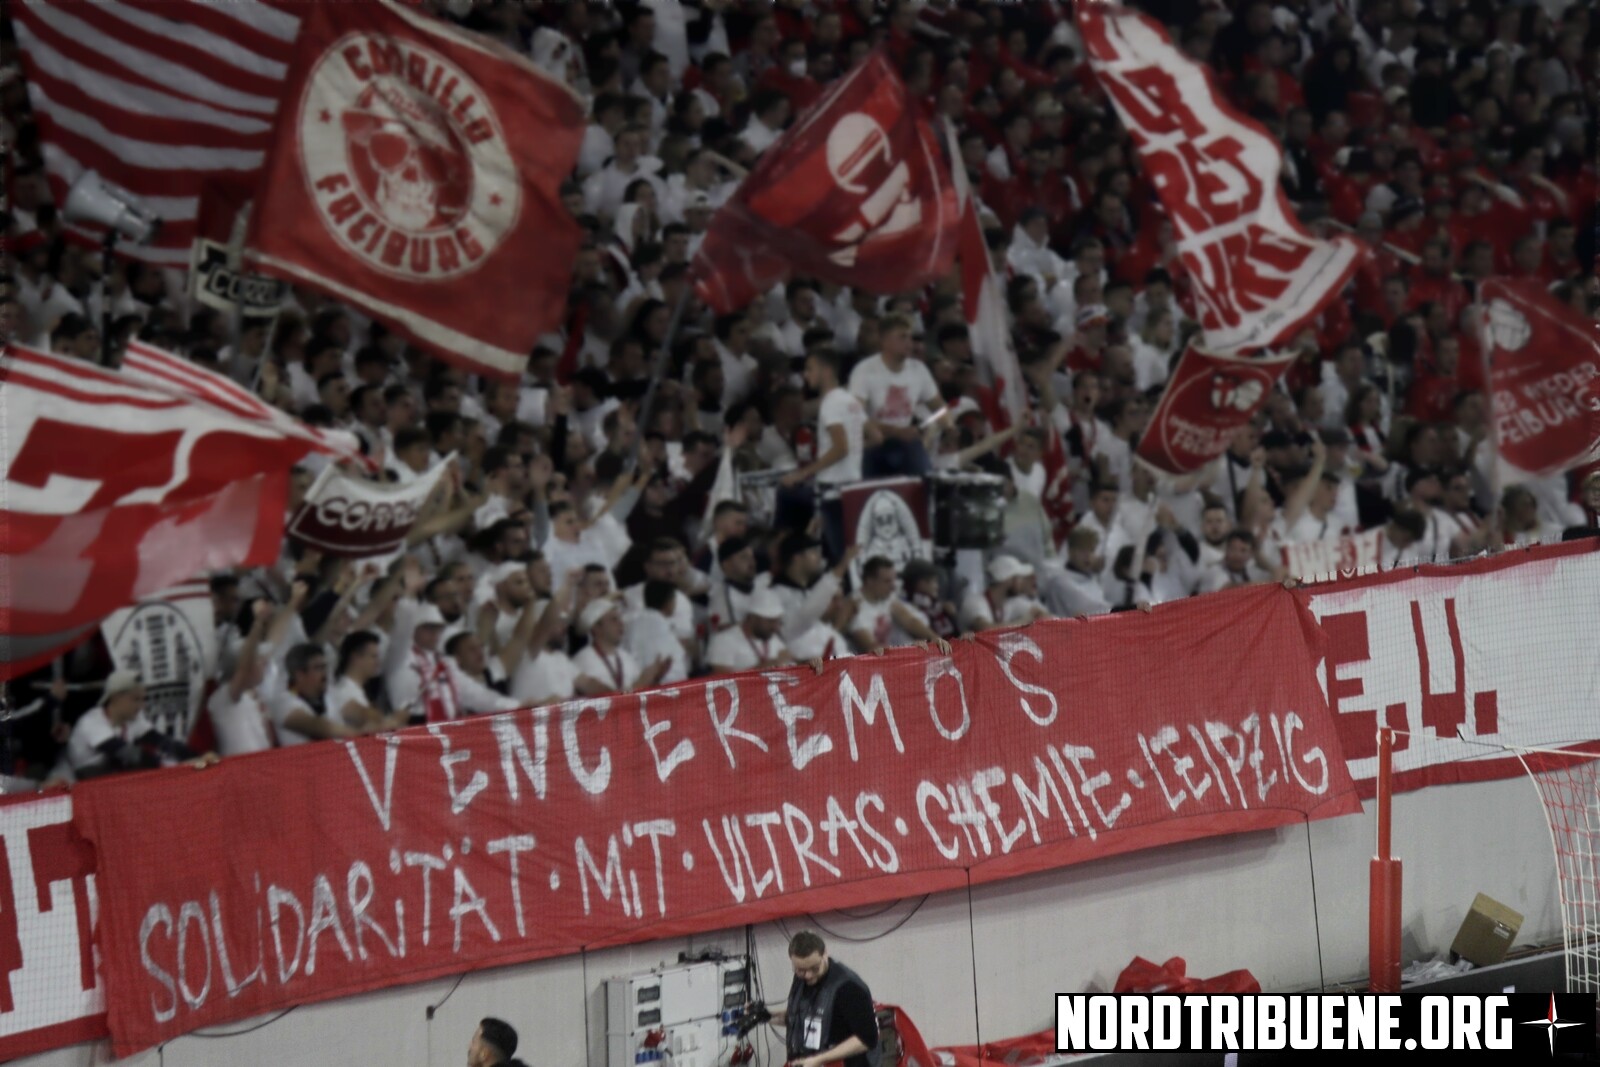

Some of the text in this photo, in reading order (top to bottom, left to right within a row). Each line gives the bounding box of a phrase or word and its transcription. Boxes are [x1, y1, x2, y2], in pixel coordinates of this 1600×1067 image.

[338, 633, 1059, 831] VENCEREMOS
[703, 791, 900, 903] ULTRAS
[915, 743, 1132, 860] CHEMIE
[1137, 710, 1330, 811] LEIPZIG
